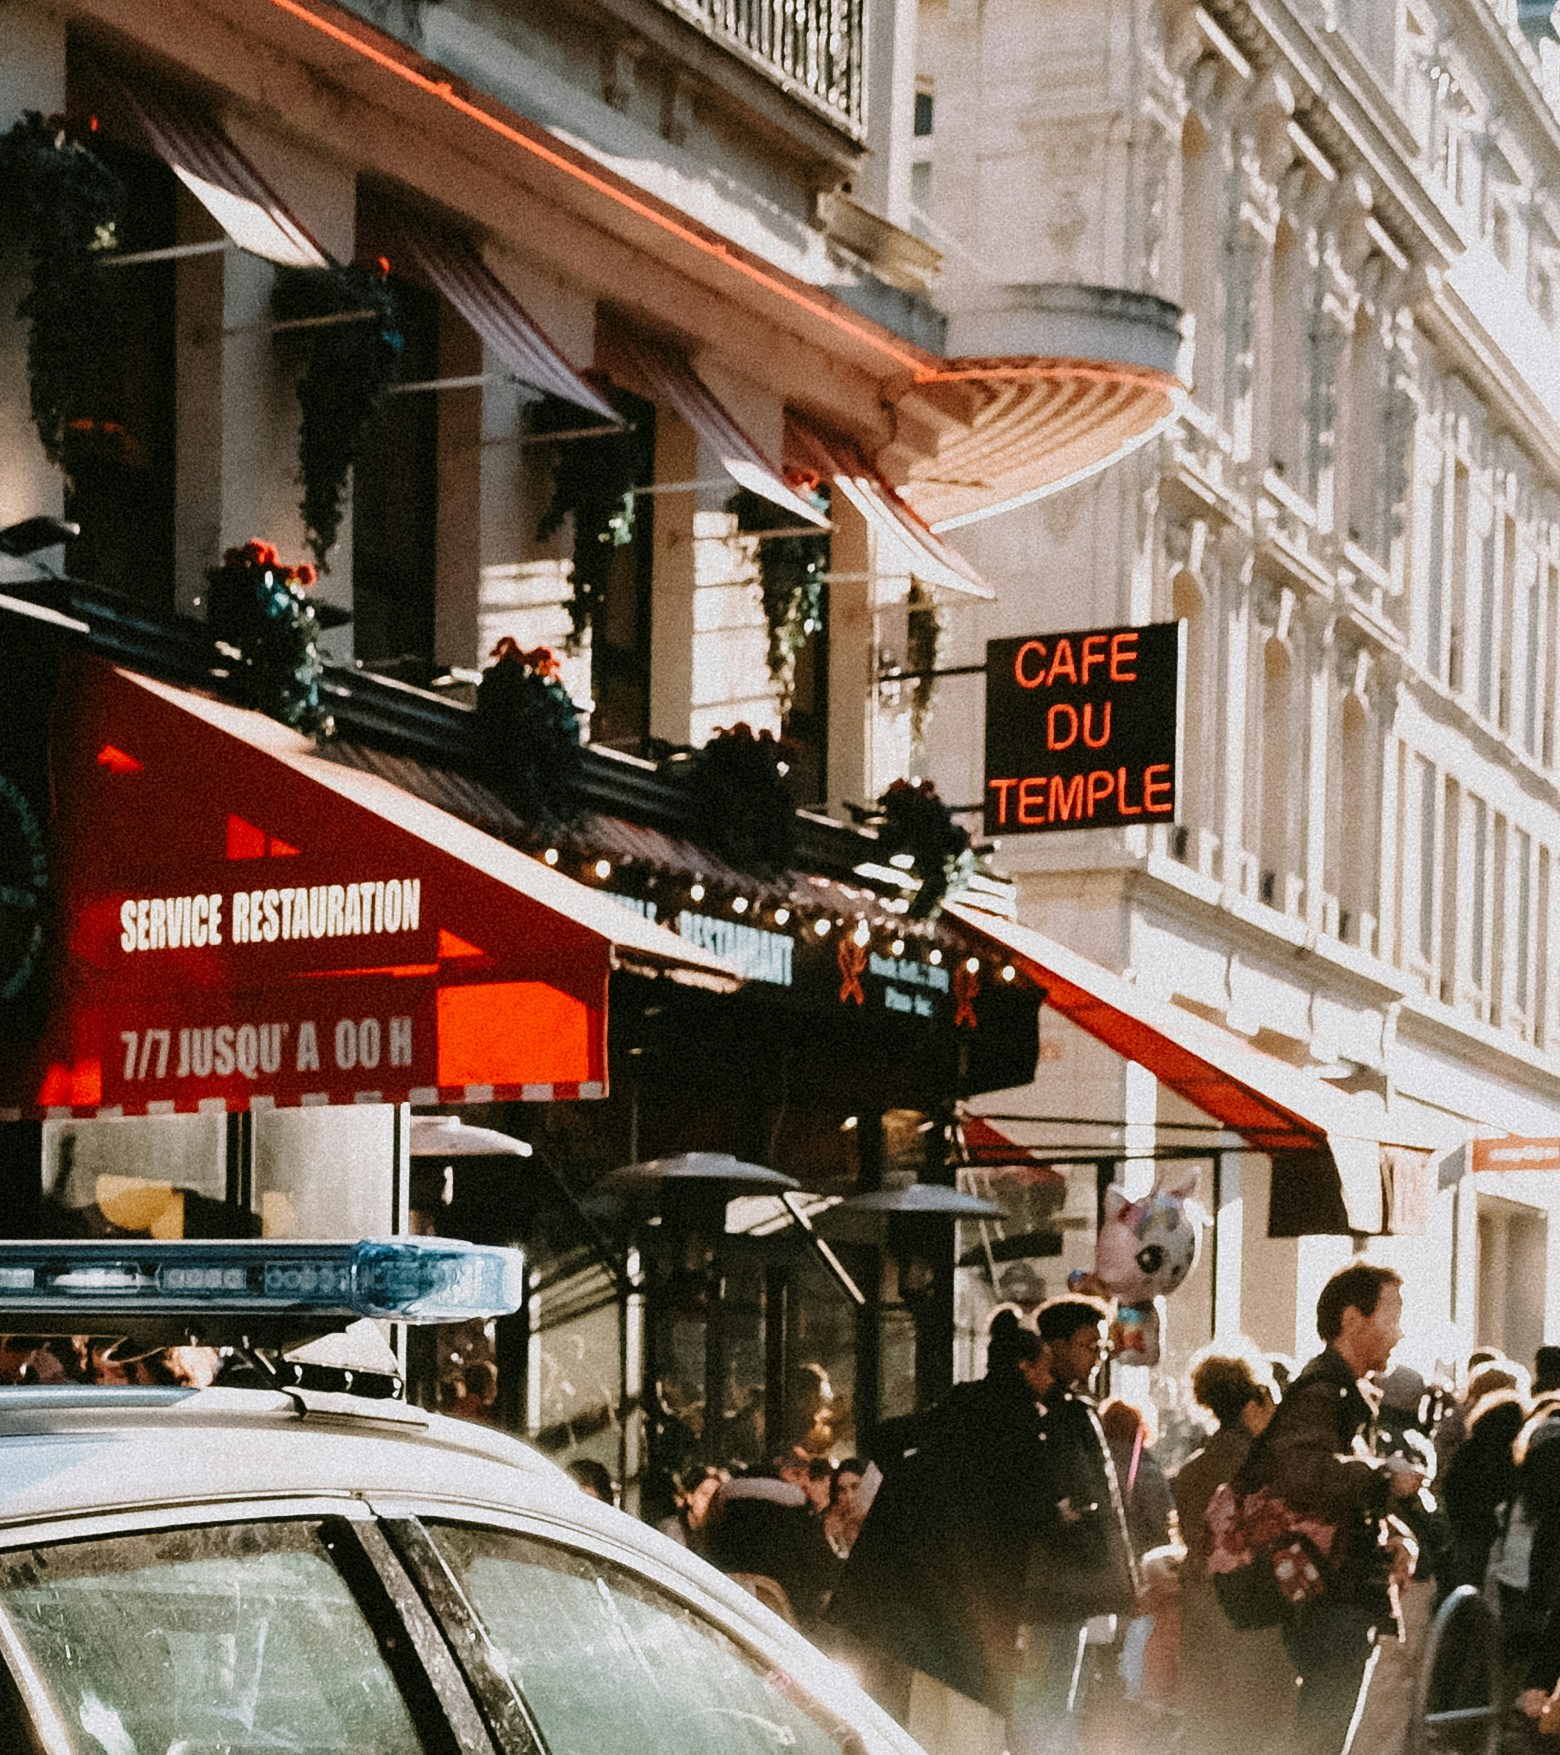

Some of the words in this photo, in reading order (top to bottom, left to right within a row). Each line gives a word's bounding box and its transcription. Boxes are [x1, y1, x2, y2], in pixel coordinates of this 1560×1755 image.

[1014, 631, 1140, 689] CAFE
[1045, 702, 1113, 752] DU
[989, 762, 1174, 827] TEMPLE
[120, 893, 223, 953] SERVICE
[232, 878, 421, 944] RESTAURATION
[120, 1028, 171, 1081] 7/7
[389, 1015, 413, 1067] H
